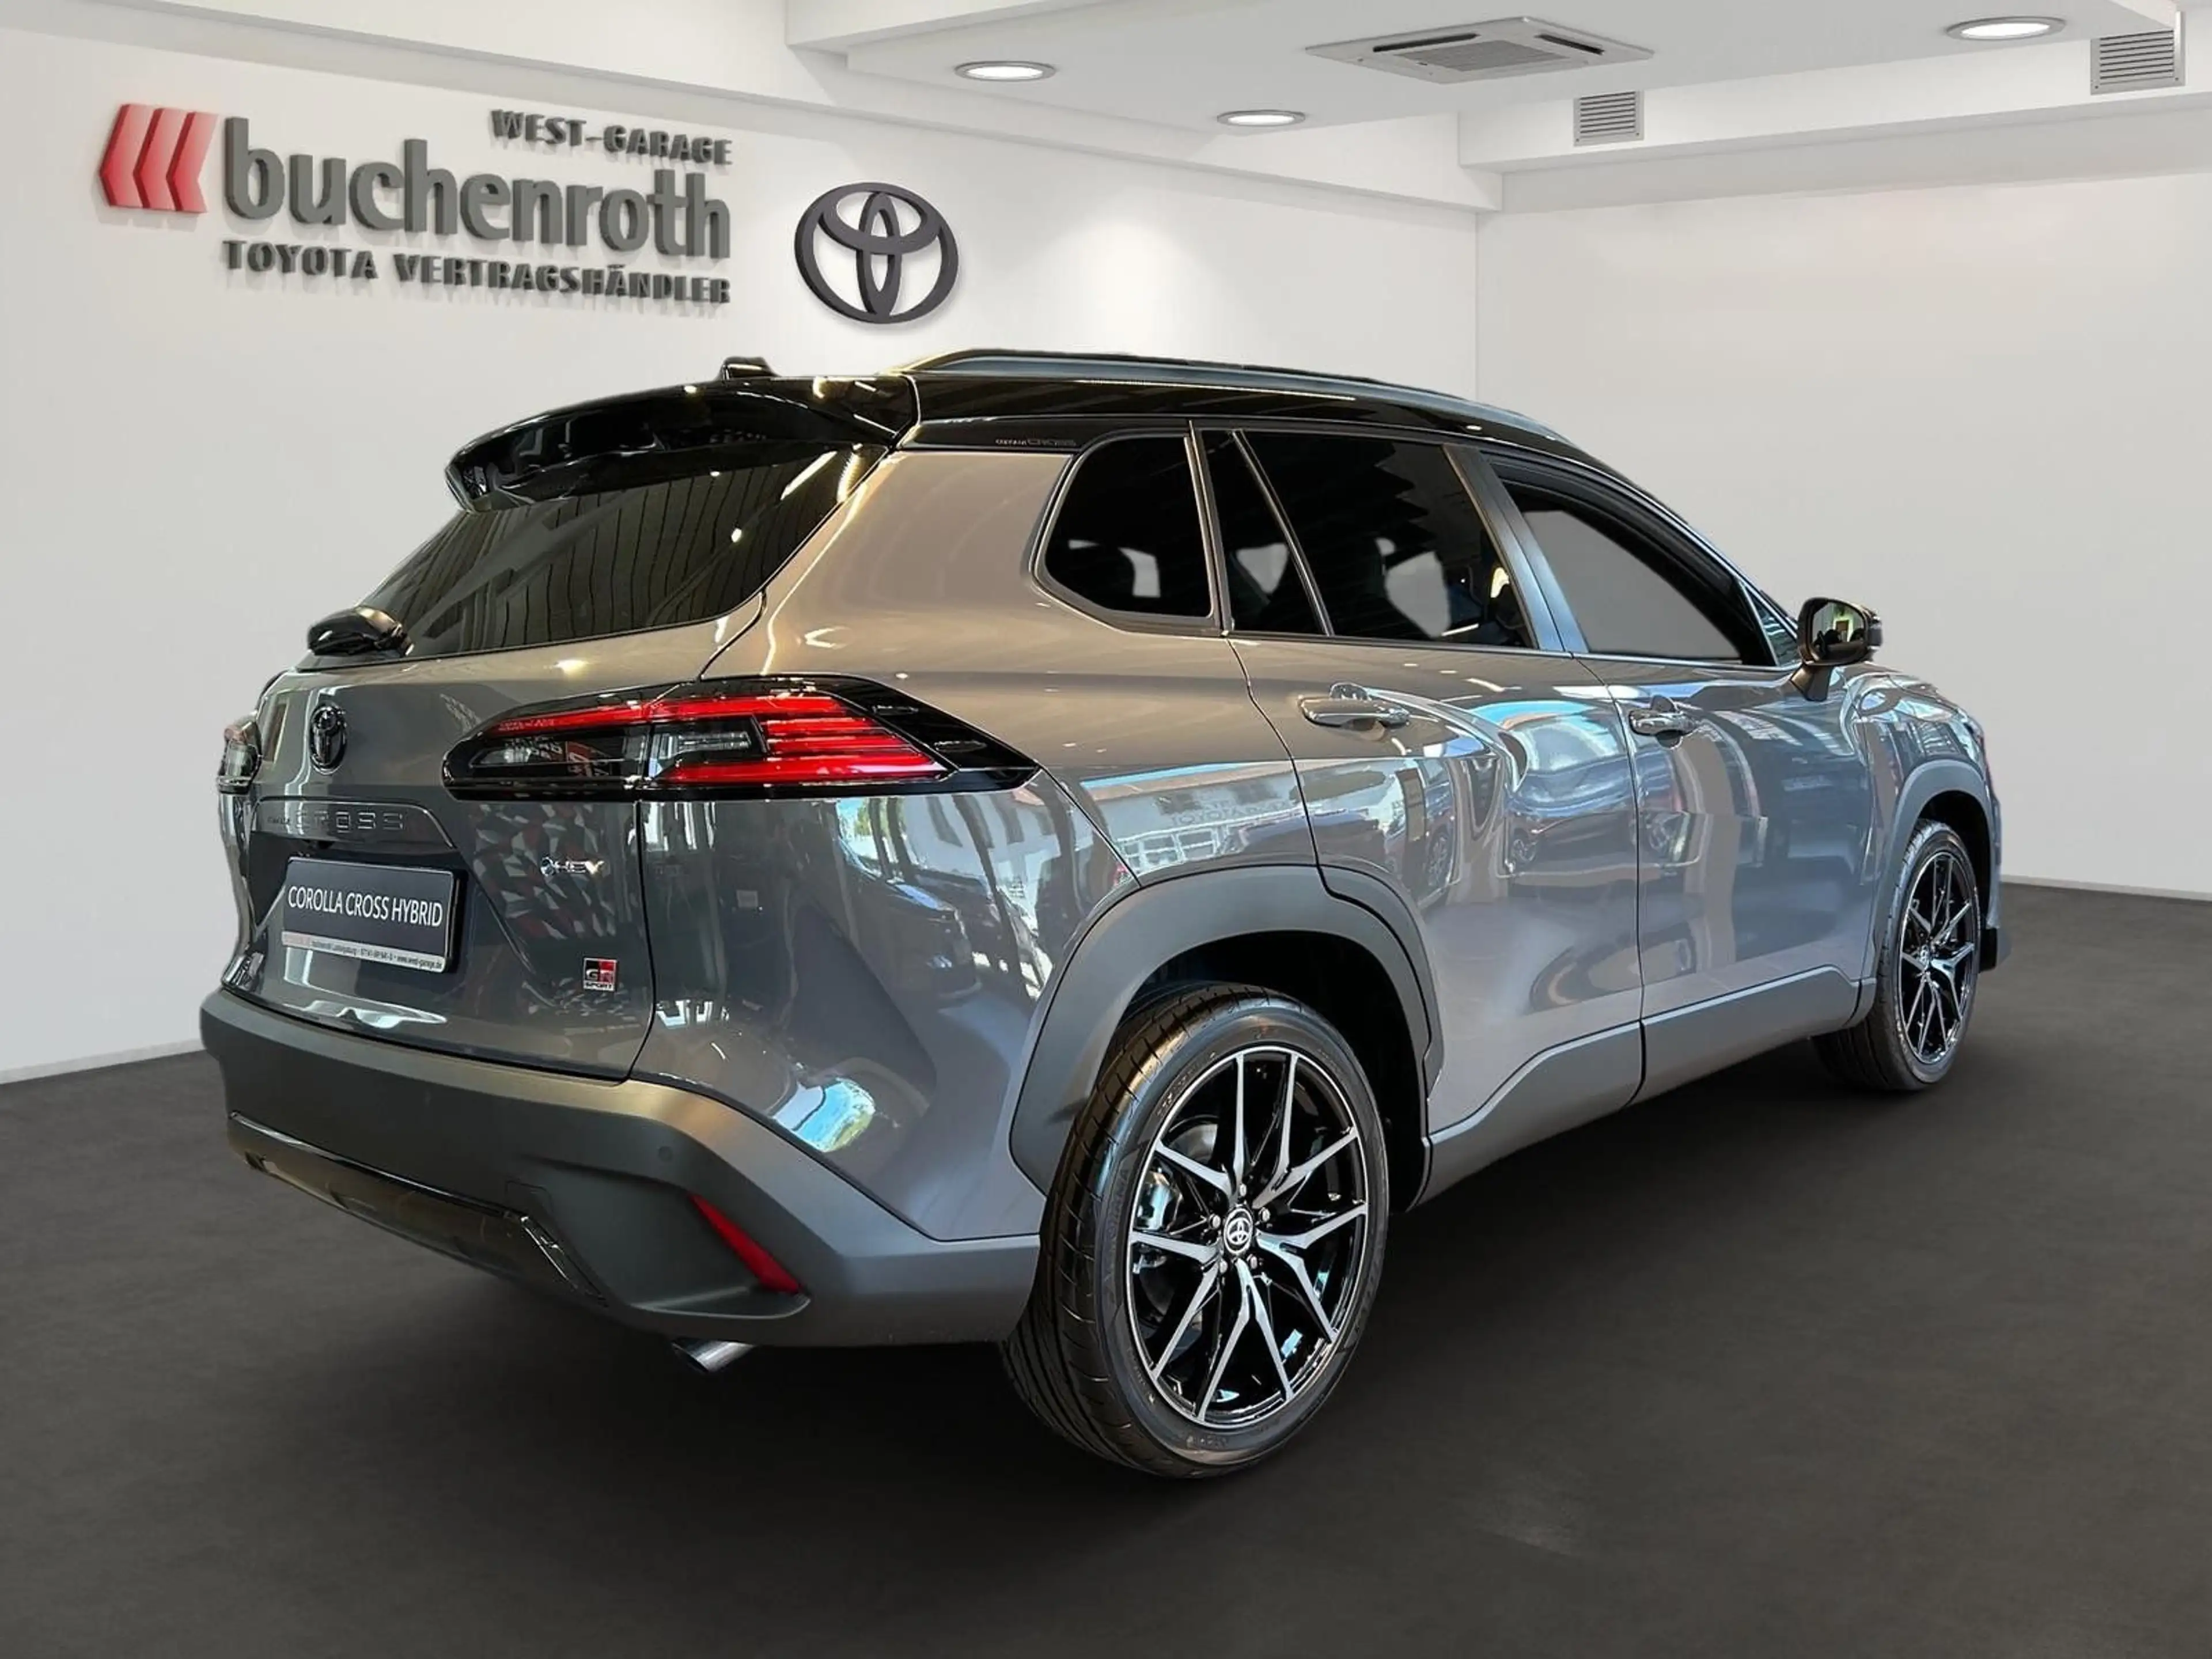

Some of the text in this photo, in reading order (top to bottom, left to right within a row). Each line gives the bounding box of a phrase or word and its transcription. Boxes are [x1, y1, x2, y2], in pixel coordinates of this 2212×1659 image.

[490, 109, 733, 165] WEST-GARAGE
[225, 117, 730, 259] buchenroth
[222, 240, 731, 304] TOYOTA VERTRAGSHÄNDLER
[288, 885, 443, 927] COROLLA CROSS HYBRID
